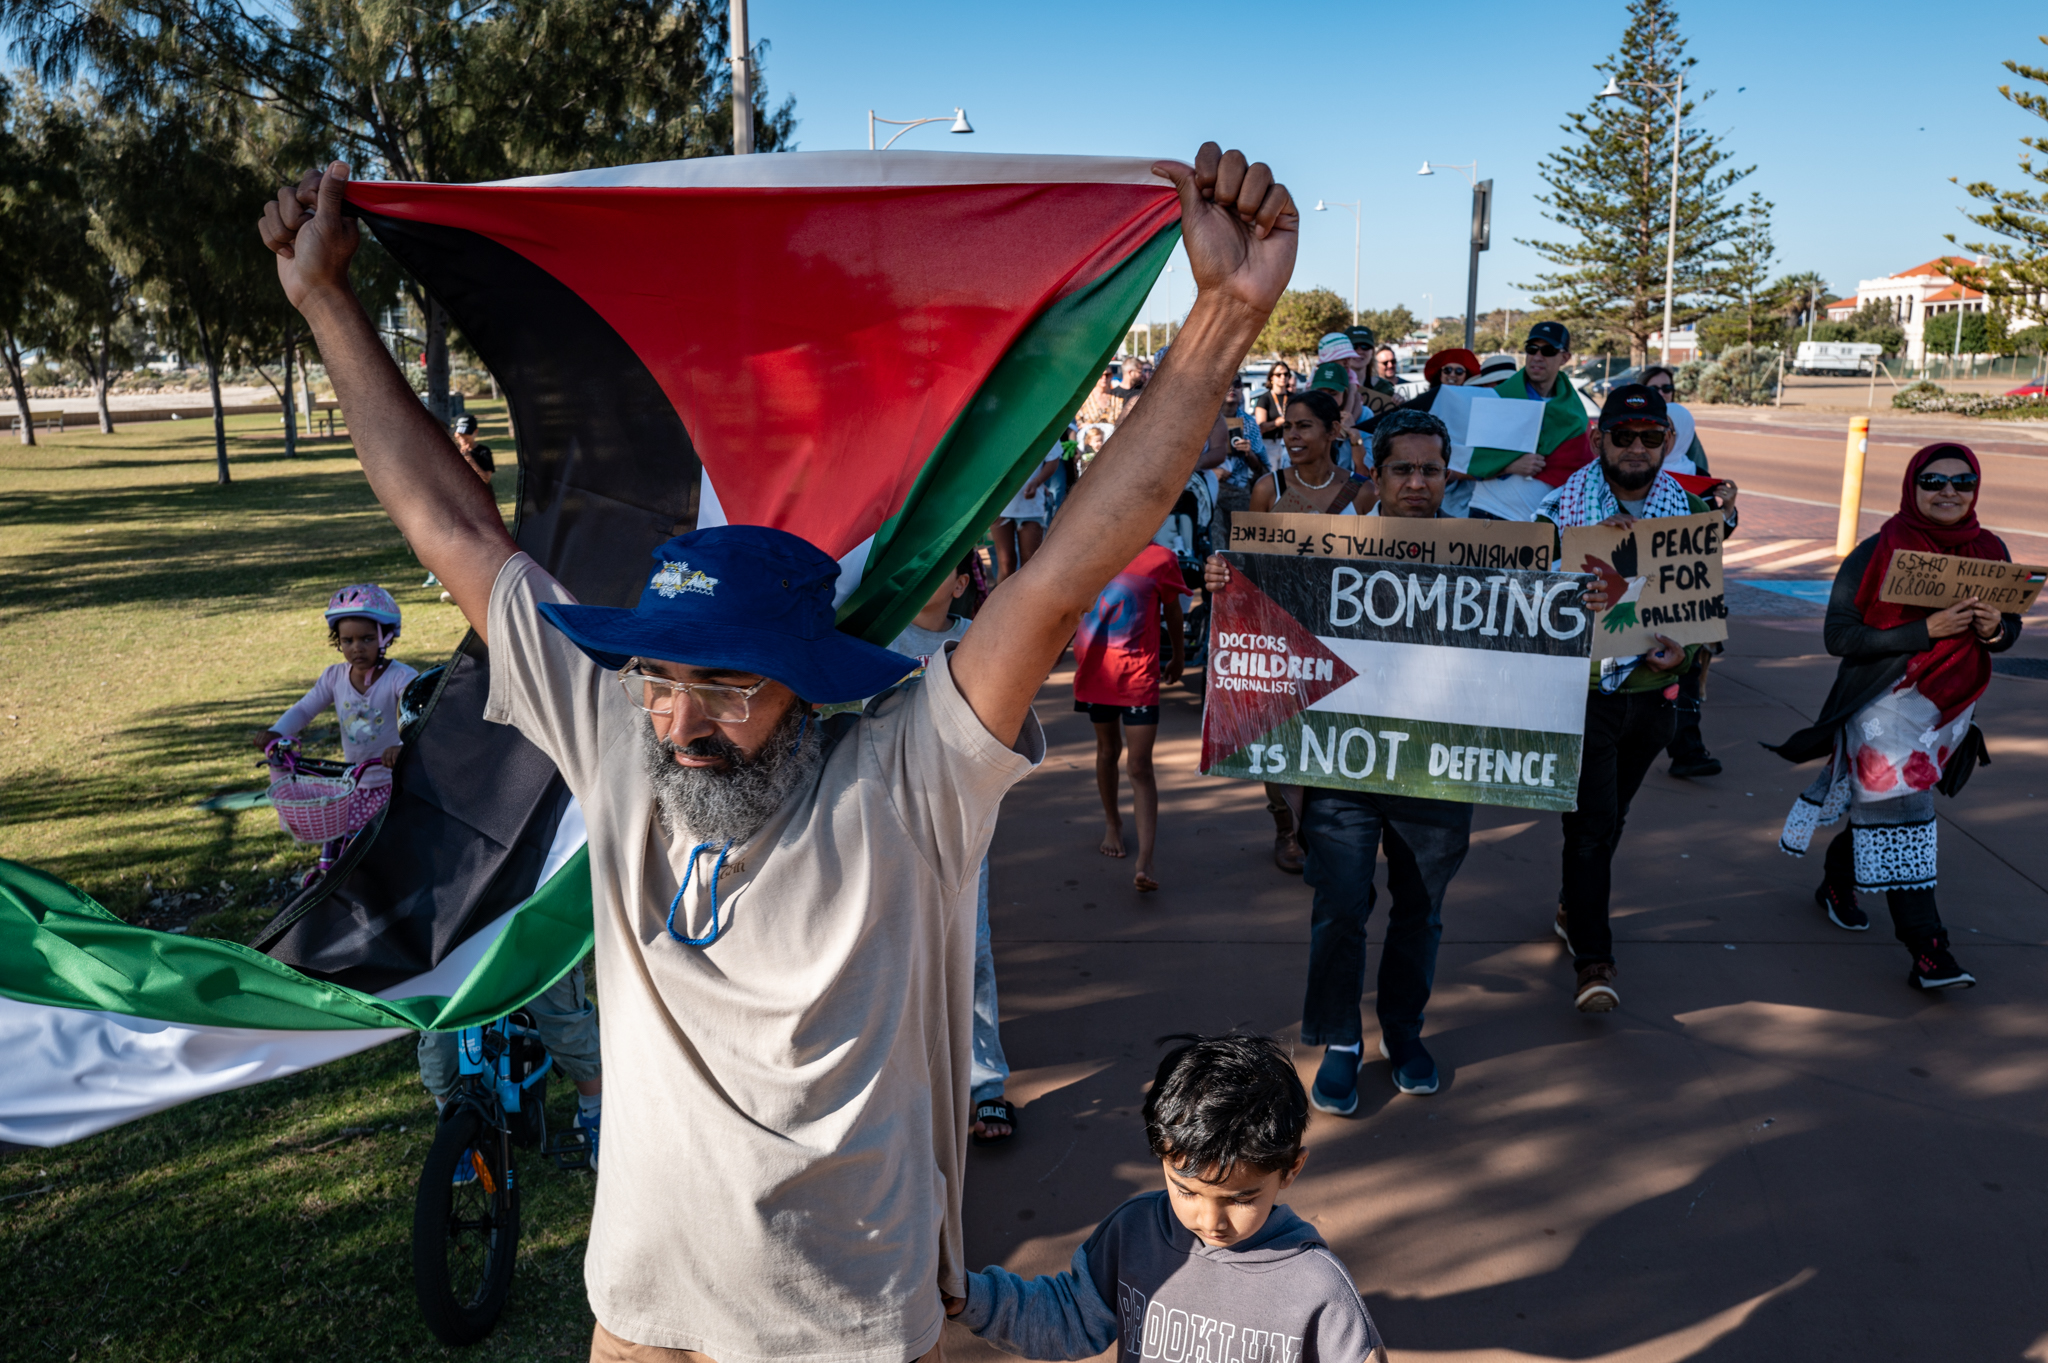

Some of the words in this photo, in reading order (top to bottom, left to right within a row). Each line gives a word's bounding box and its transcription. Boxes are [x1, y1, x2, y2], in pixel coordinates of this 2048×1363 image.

[1232, 526, 1296, 544] DEFENCE
[1322, 532, 1436, 563] HOSPITALS
[1651, 522, 1720, 558] PEACE
[1449, 541, 1549, 571] BOMBING
[1956, 560, 2006, 579] KILLED
[1659, 561, 1711, 594] FOR
[1329, 566, 1587, 641] BOMBING
[1641, 594, 1728, 628] PALESTINE
[1218, 632, 1287, 653] DOCTORS
[1213, 650, 1334, 682] CHILDREN
[1215, 676, 1297, 696] JOURNALISTS
[1248, 743, 1287, 775] IS
[1300, 724, 1410, 781] NOT
[1428, 743, 1558, 788] DEFENCE
